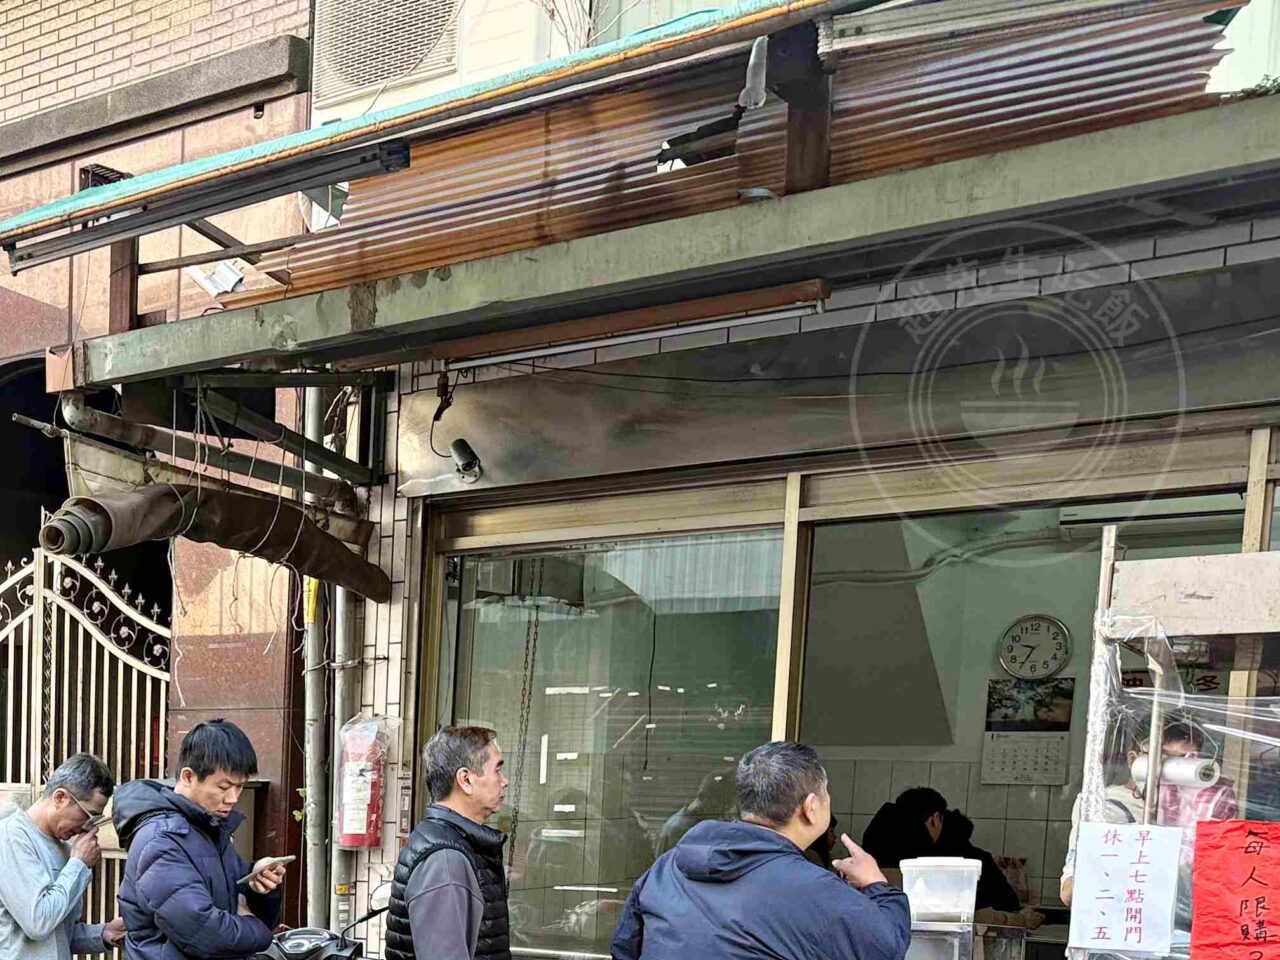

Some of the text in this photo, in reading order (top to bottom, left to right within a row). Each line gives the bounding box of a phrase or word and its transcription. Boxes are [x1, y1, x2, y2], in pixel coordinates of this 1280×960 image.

[1020, 627, 1029, 635] 11
[1030, 622, 1041, 632] 12
[1011, 635, 1021, 643] 10
[1052, 632, 1059, 641] 2
[1007, 645, 1014, 653] 9
[1055, 642, 1062, 651] 3
[1010, 655, 1017, 664] 8
[1051, 653, 1058, 661] 4
[1030, 664, 1037, 673] 6
[1042, 661, 1049, 669] 5
[1091, 829, 1123, 941] 休一、二、五
[1124, 830, 1154, 944] 早上七點開門
